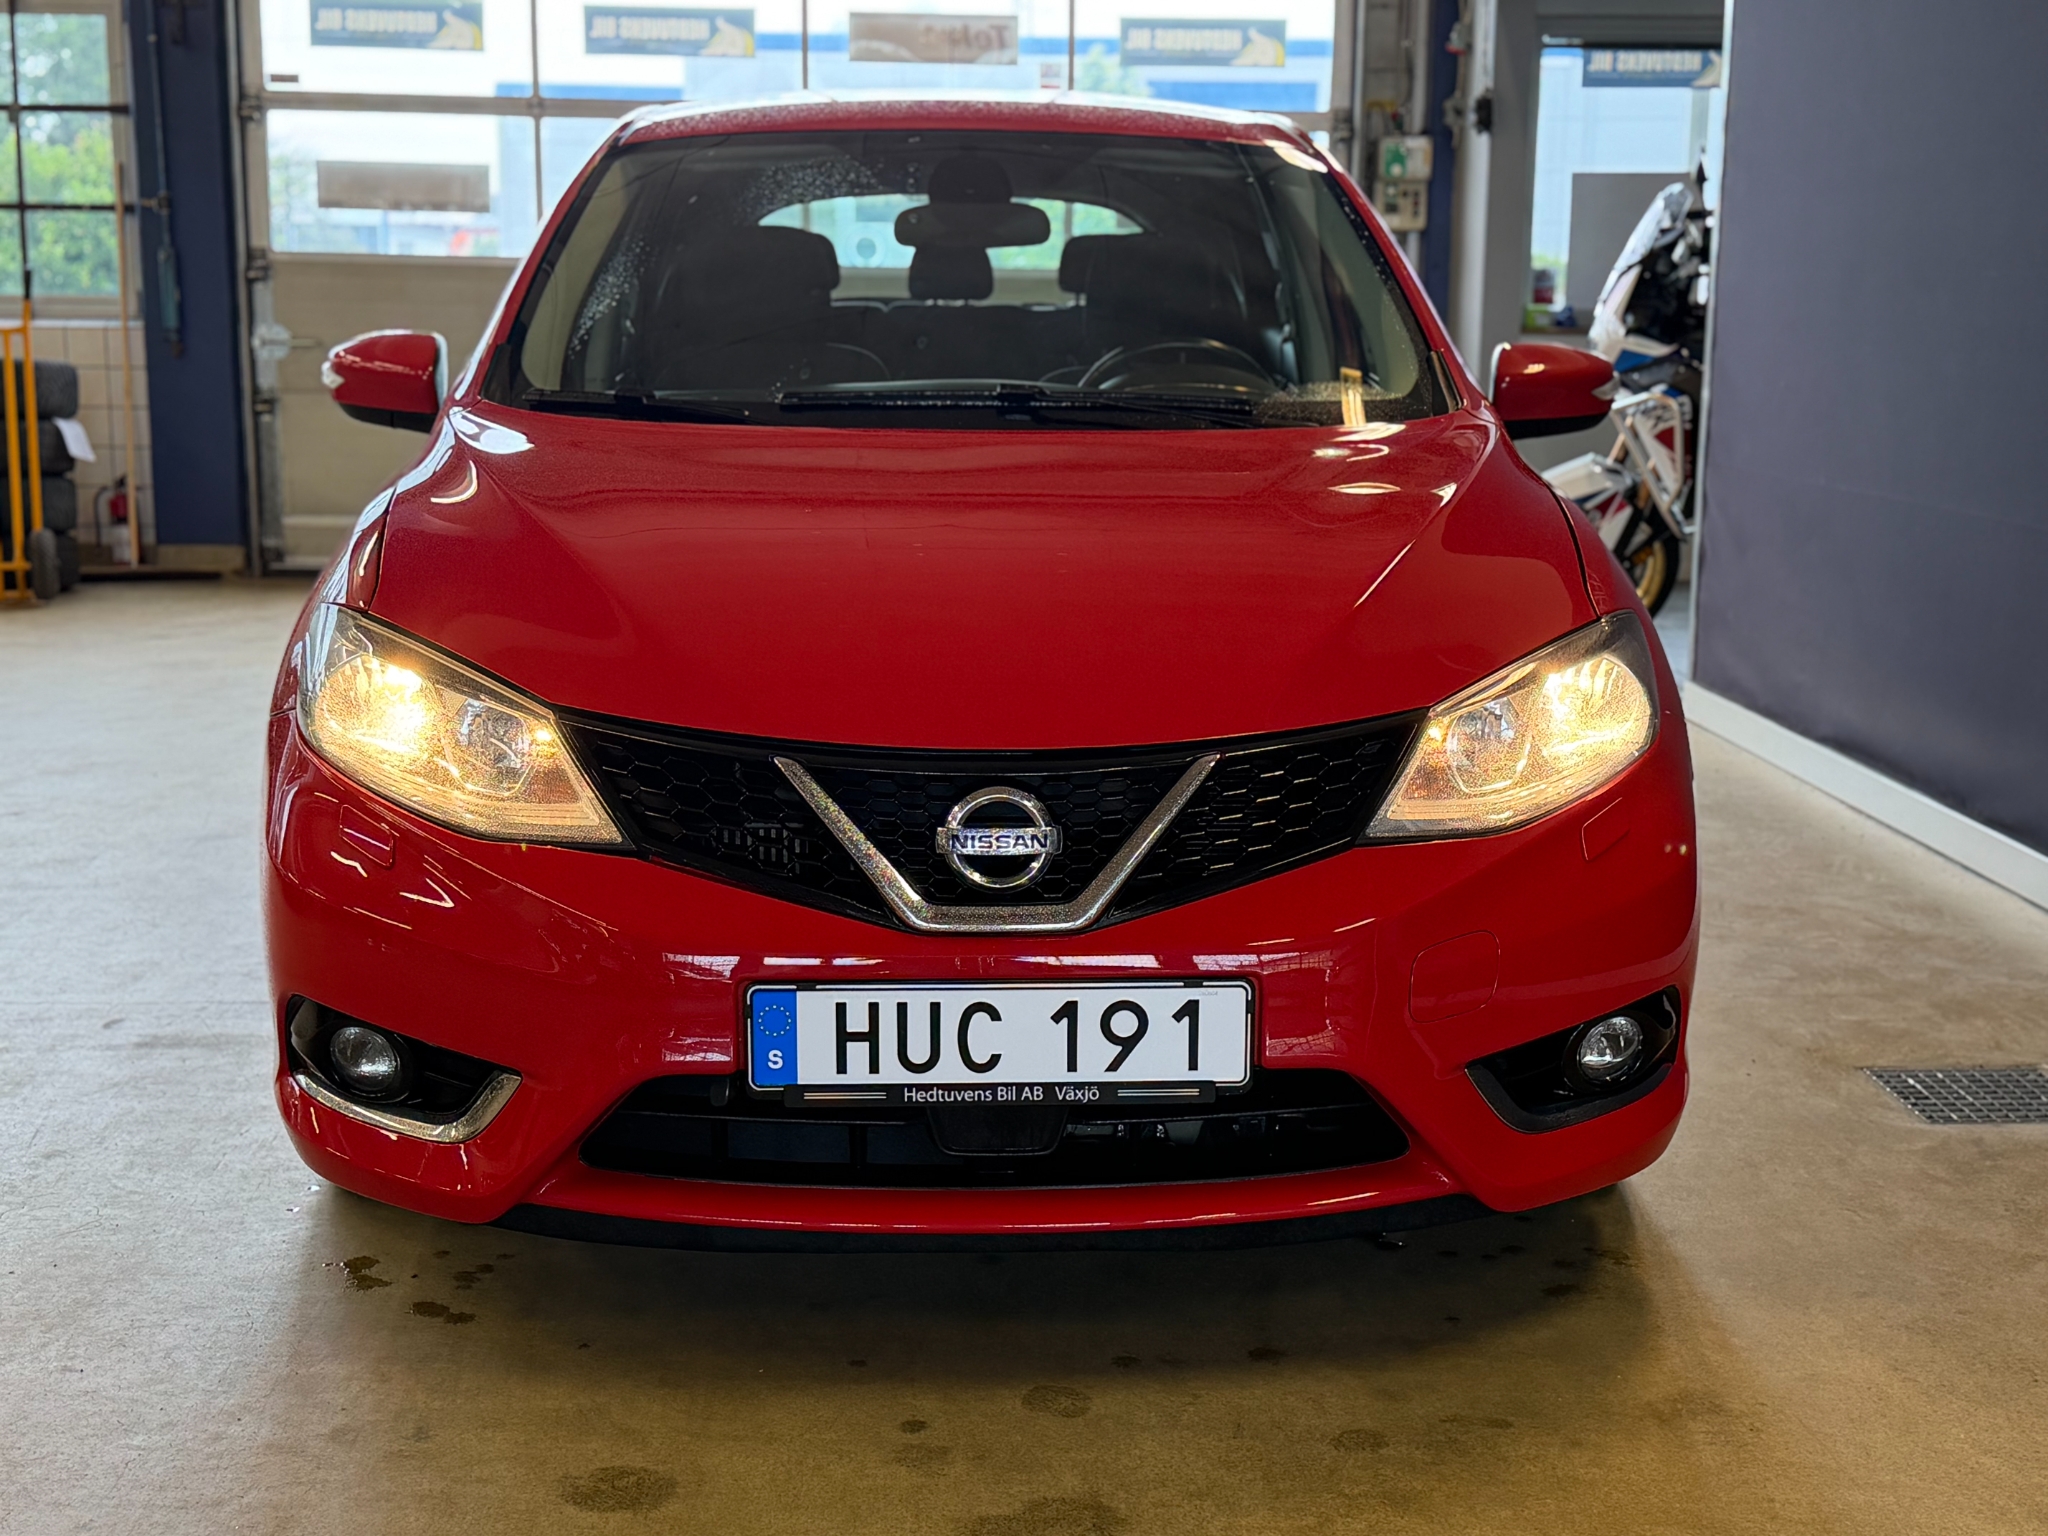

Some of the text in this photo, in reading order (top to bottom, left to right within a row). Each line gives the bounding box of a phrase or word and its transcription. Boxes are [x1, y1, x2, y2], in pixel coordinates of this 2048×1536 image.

[951, 834, 1048, 849] NISSAN
[835, 999, 1201, 1075] HUC 191
[767, 1050, 784, 1069] S
[904, 1086, 1101, 1103] Hedtuvens Bil AB Växjö
